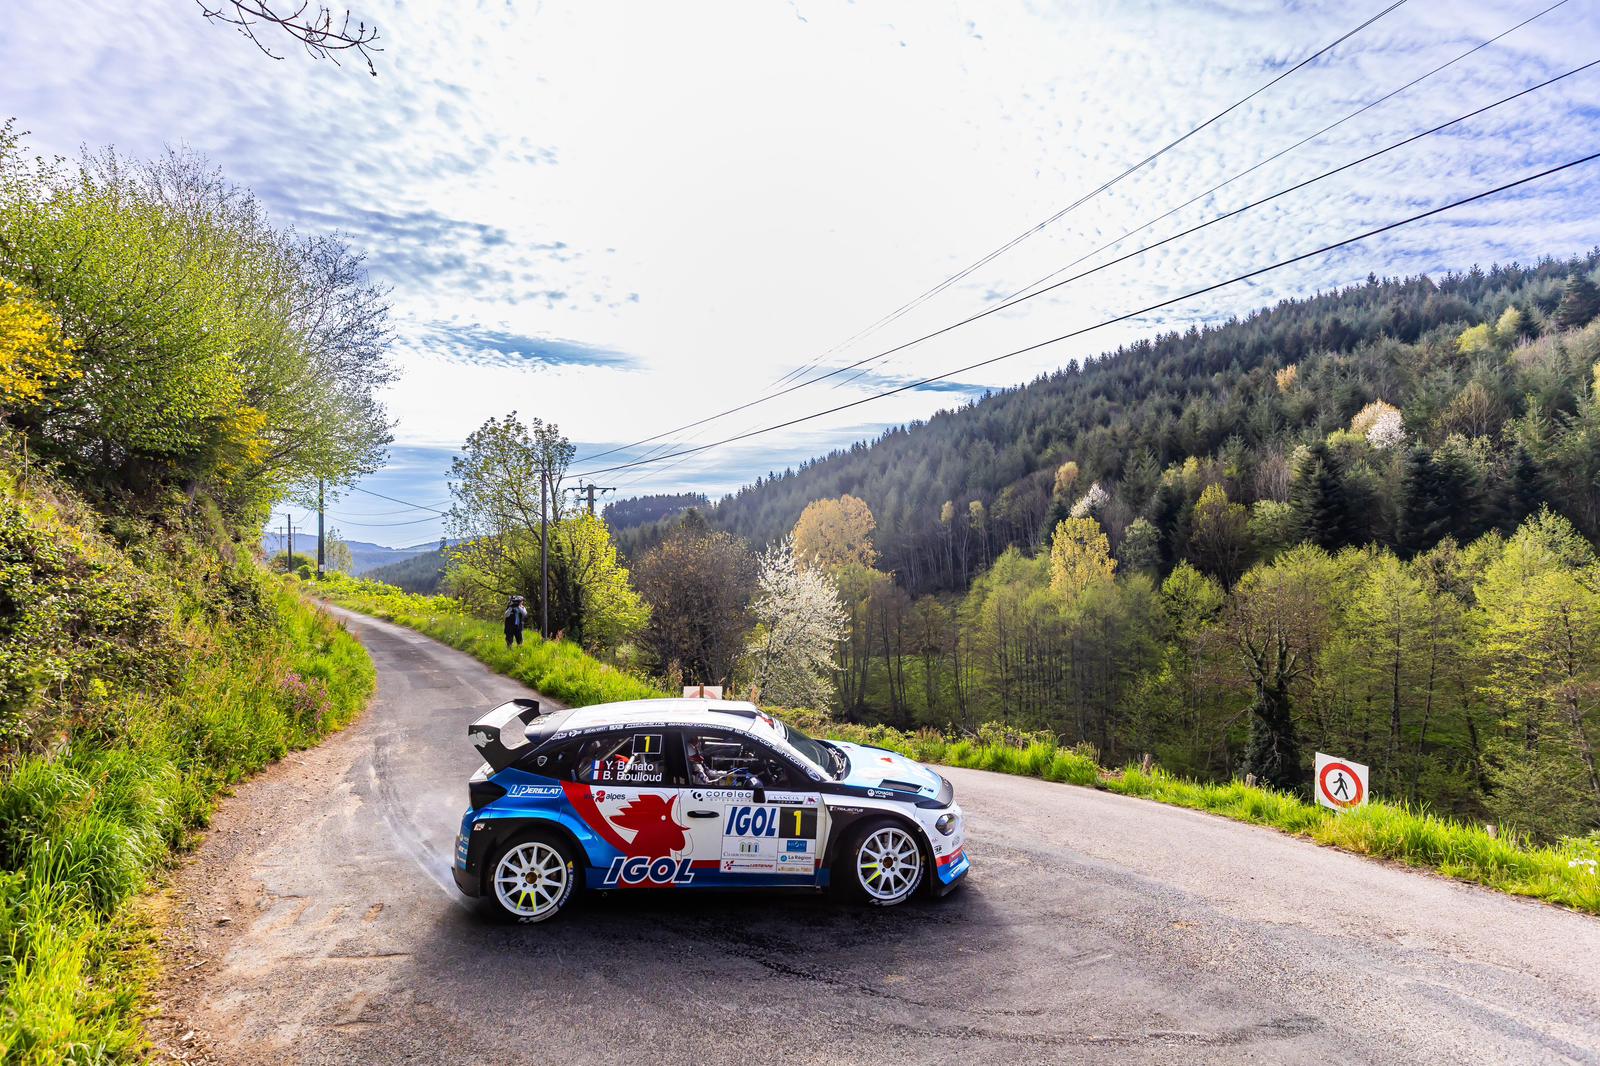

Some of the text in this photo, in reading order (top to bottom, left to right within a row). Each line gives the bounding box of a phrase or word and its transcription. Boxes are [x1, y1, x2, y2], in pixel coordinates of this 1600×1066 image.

[644, 736, 651, 753] 1
[605, 760, 614, 770] Y.
[603, 771, 663, 782] B. Boulloud
[606, 793, 626, 801] alpes
[705, 790, 752, 798] corelec
[725, 806, 777, 837] IGOL
[793, 810, 802, 836] 1
[603, 856, 695, 884] IGOL
